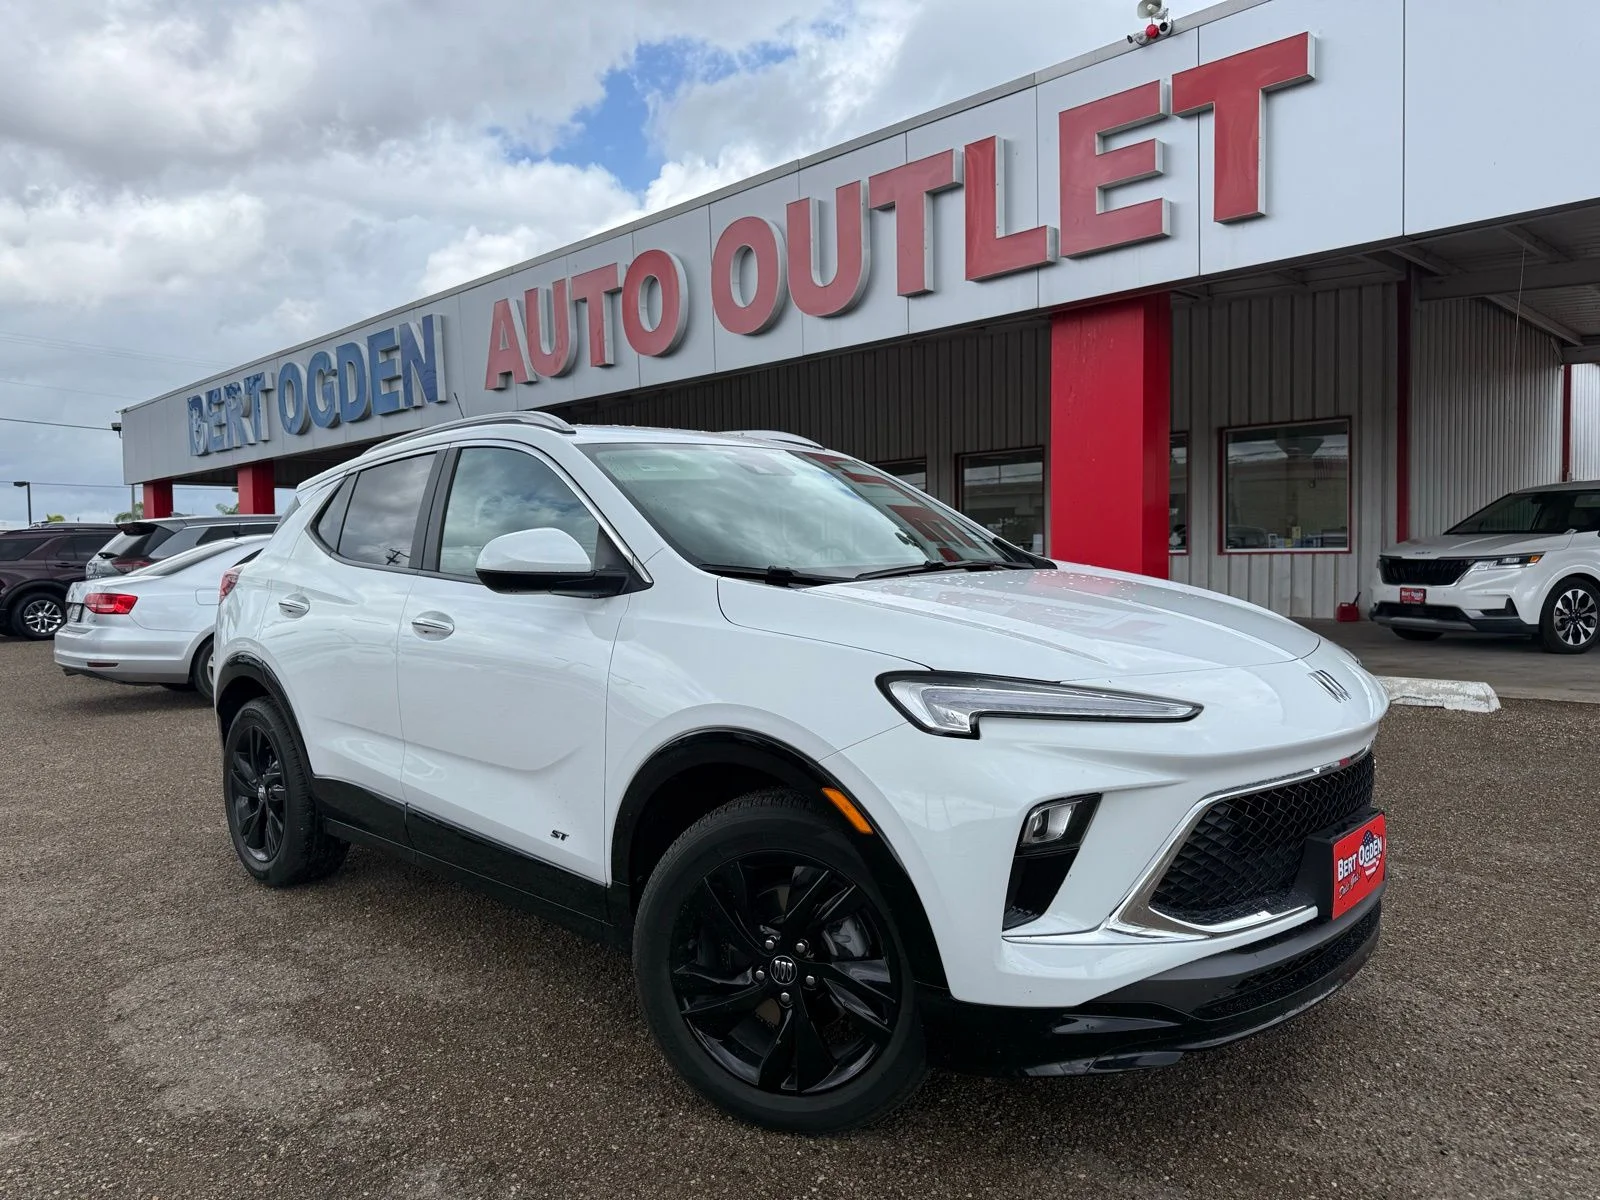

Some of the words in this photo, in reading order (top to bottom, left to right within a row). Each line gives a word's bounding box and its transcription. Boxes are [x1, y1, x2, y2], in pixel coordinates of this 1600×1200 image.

[187, 371, 273, 456] BERT
[278, 313, 448, 435] OGDEN
[485, 249, 689, 391] AUTO
[711, 31, 1316, 336] OUTLET
[550, 829, 570, 841] ST
[1337, 853, 1357, 881] BERT
[1358, 836, 1382, 866] OGDEN
